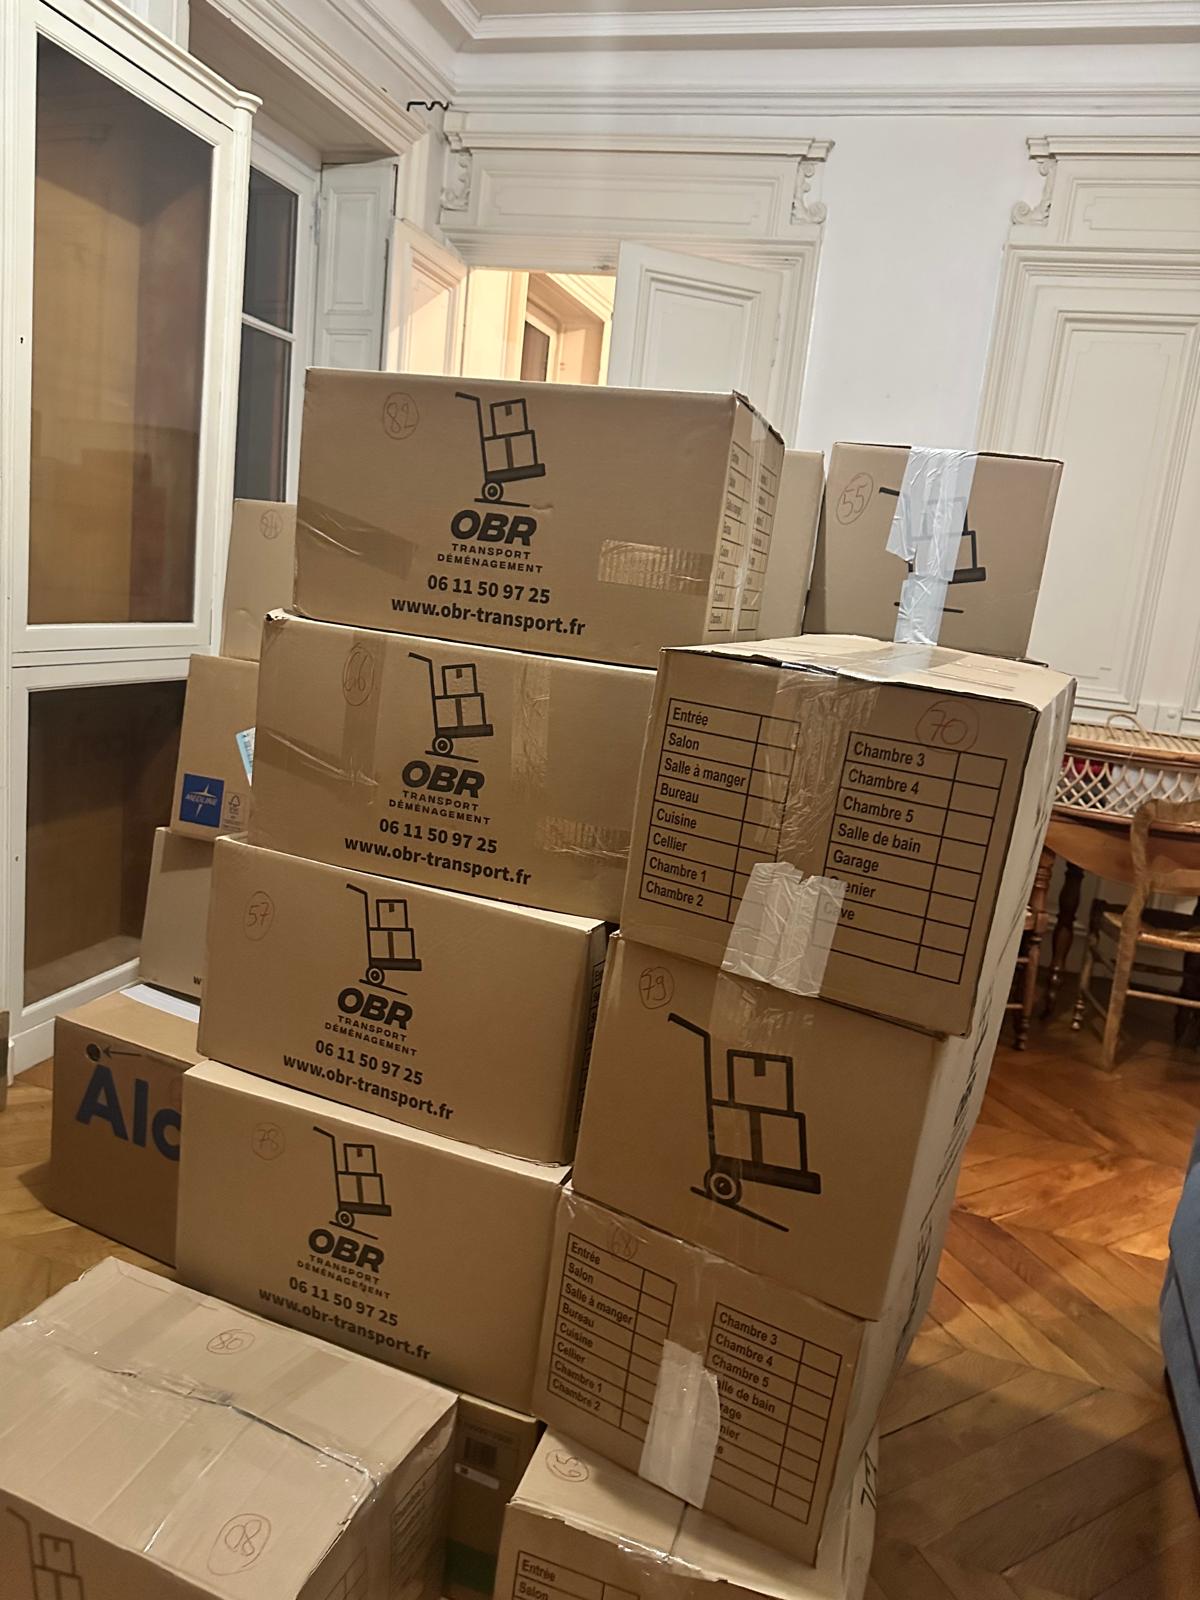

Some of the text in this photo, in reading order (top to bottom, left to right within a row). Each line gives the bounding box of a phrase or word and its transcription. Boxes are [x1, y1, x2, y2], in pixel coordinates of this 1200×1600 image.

[451, 509, 537, 546] OBR
[437, 553, 543, 573] DÉMÉNAGEMENT
[452, 543, 531, 560] TRANSPORT
[428, 575, 550, 604] 06 11 50 97 25
[391, 599, 586, 635] www.obr-transport.fr
[672, 707, 708, 727] Entrée
[668, 732, 699, 751] Salon
[854, 741, 925, 767] Chambre 3
[402, 760, 485, 798] OBR
[664, 757, 746, 788] Salle à manger
[848, 768, 920, 795] Chambre 4
[402, 790, 478, 811] TRANSPORT
[660, 783, 699, 804] Bureau
[389, 799, 491, 825] DÉMÉNAGEMENT
[656, 808, 697, 829] Cuisine
[843, 795, 914, 823] Chambre 5
[379, 818, 497, 854] 06 11 50 97 25
[653, 832, 688, 852] Cellier
[838, 823, 921, 854] Salle de bain
[344, 837, 532, 885] www.obr-transport.fr
[649, 856, 707, 883] Chambre 1
[833, 850, 879, 873] Garage
[646, 880, 704, 907] Chambre 2
[337, 987, 413, 1031] OBR
[325, 1022, 417, 1057] DÉMÉNAGEMENT
[337, 1015, 407, 1042] TRANSPORT
[316, 1039, 423, 1085] 06 11 50 97 25
[283, 1054, 454, 1120] www.obr-transport.fr
[308, 1228, 385, 1274] OBR
[571, 1242, 601, 1265] Entrée
[309, 1254, 381, 1285] TRANSPORT
[567, 1262, 594, 1284] Salon
[289, 1276, 399, 1327] 06 11 50 97 25
[565, 1283, 634, 1325] Salle à manger
[258, 1287, 431, 1361] www.obr-transport.fr
[562, 1303, 595, 1328] Bureau
[720, 1311, 778, 1346] Chambre 3
[559, 1322, 594, 1348] Cuisine
[557, 1342, 586, 1364] Cellier
[716, 1333, 774, 1367] Chambre 4
[554, 1361, 595, 1389] Chambre
[712, 1354, 769, 1388] Chambre 5
[552, 1378, 601, 1411] Chambre 2
[717, 1378, 775, 1414] alle de bain
[719, 1402, 742, 1421] rage
[719, 1424, 740, 1441] nier
[522, 1559, 556, 1581] Entrée
[518, 1582, 549, 1600] Salon
